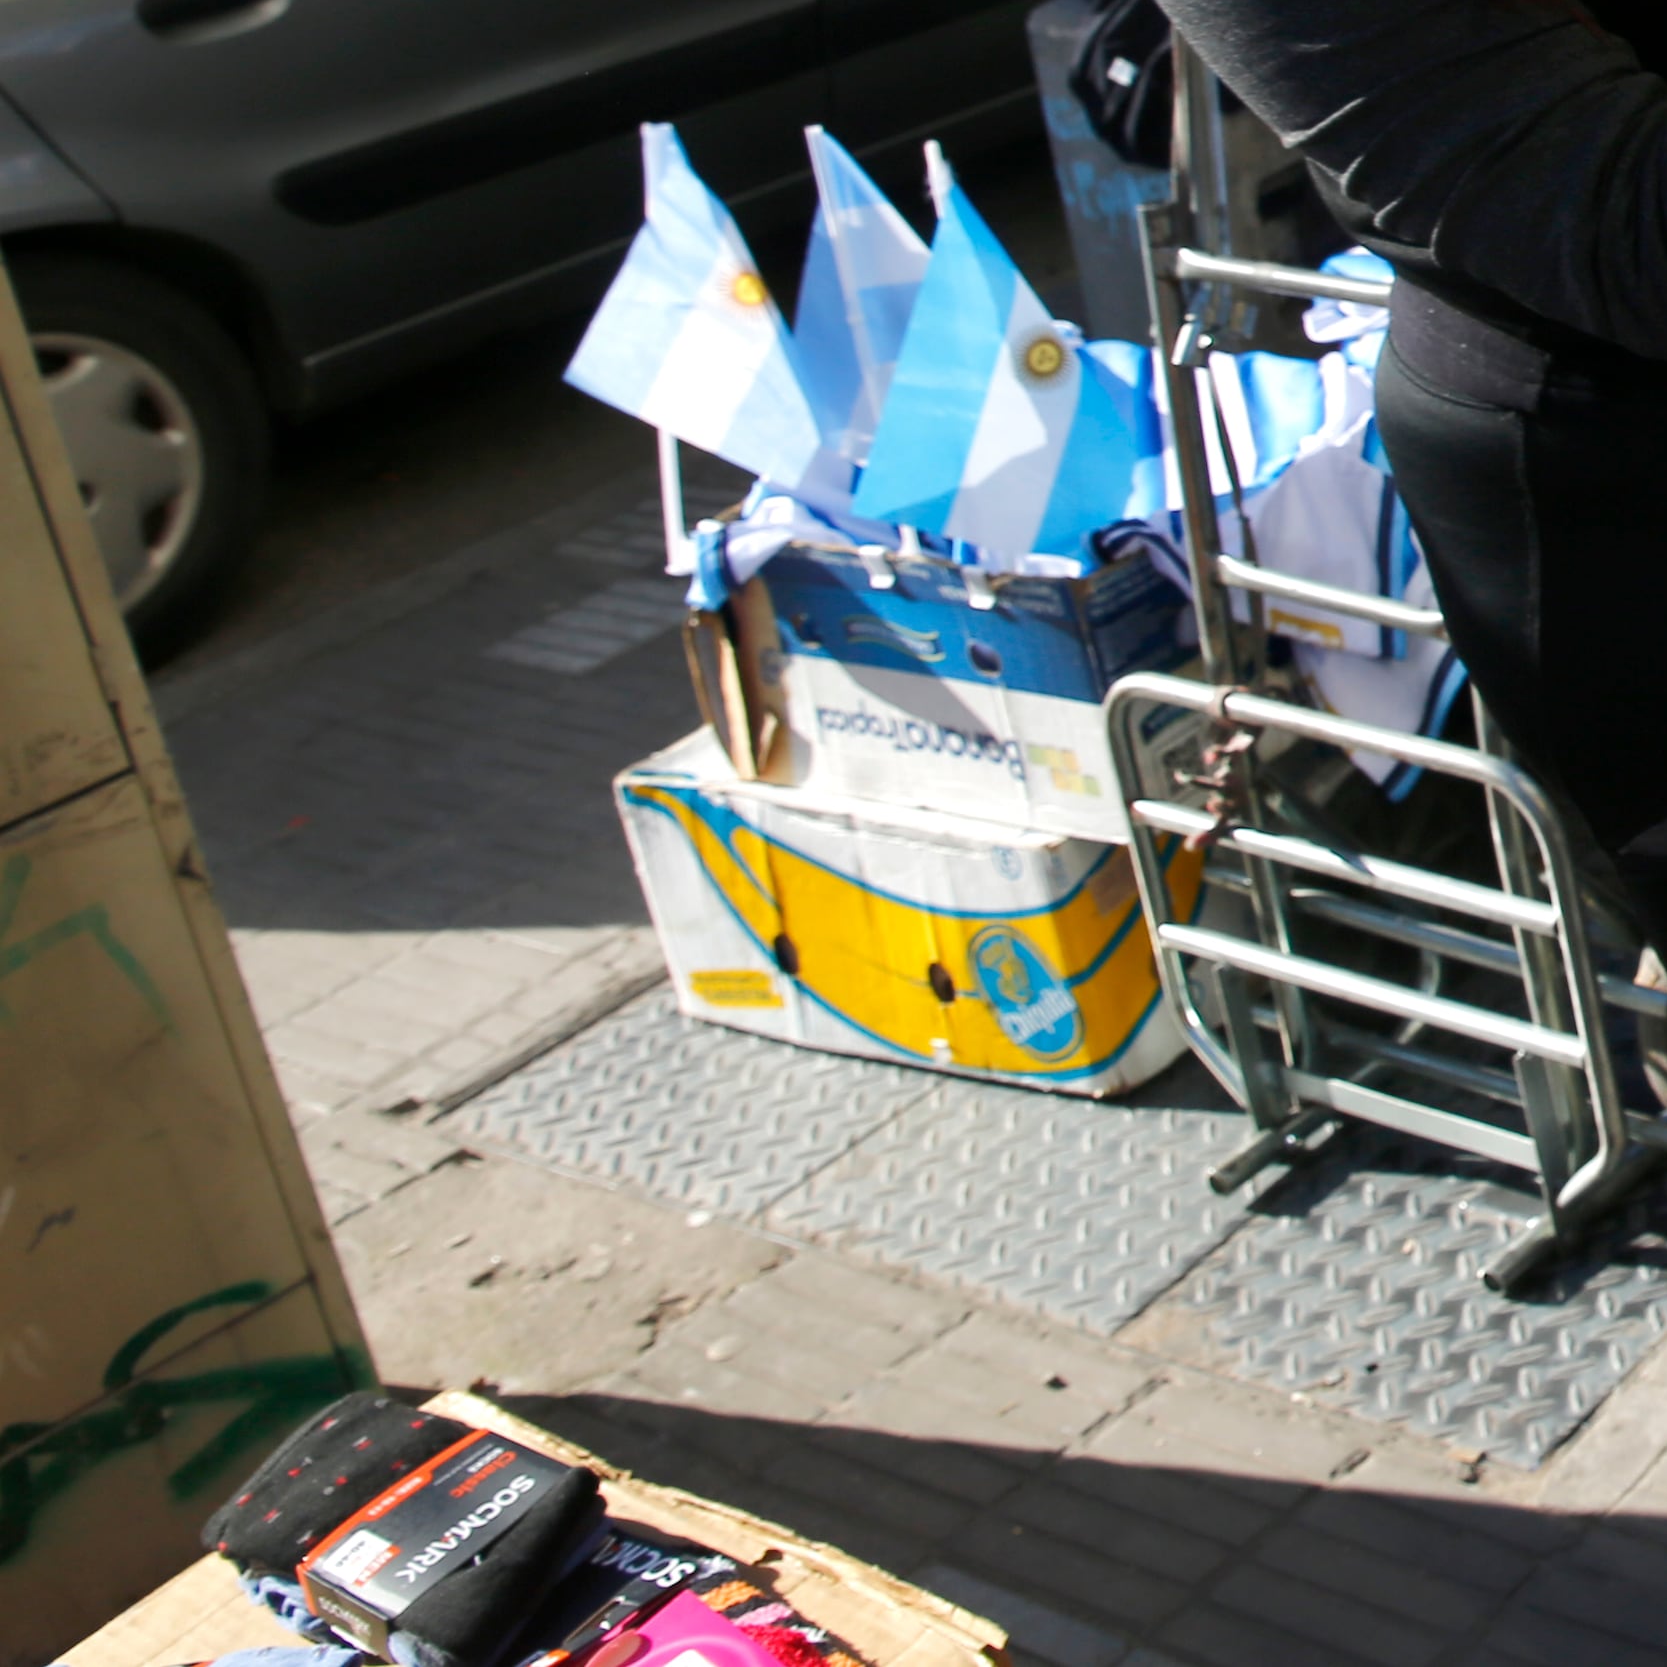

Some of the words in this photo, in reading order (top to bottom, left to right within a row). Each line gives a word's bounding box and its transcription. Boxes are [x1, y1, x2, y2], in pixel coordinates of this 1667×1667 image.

[448, 1449, 518, 1500] Classic
[394, 1474, 537, 1584] SOCMARK
[591, 1536, 697, 1589] SOCMA
